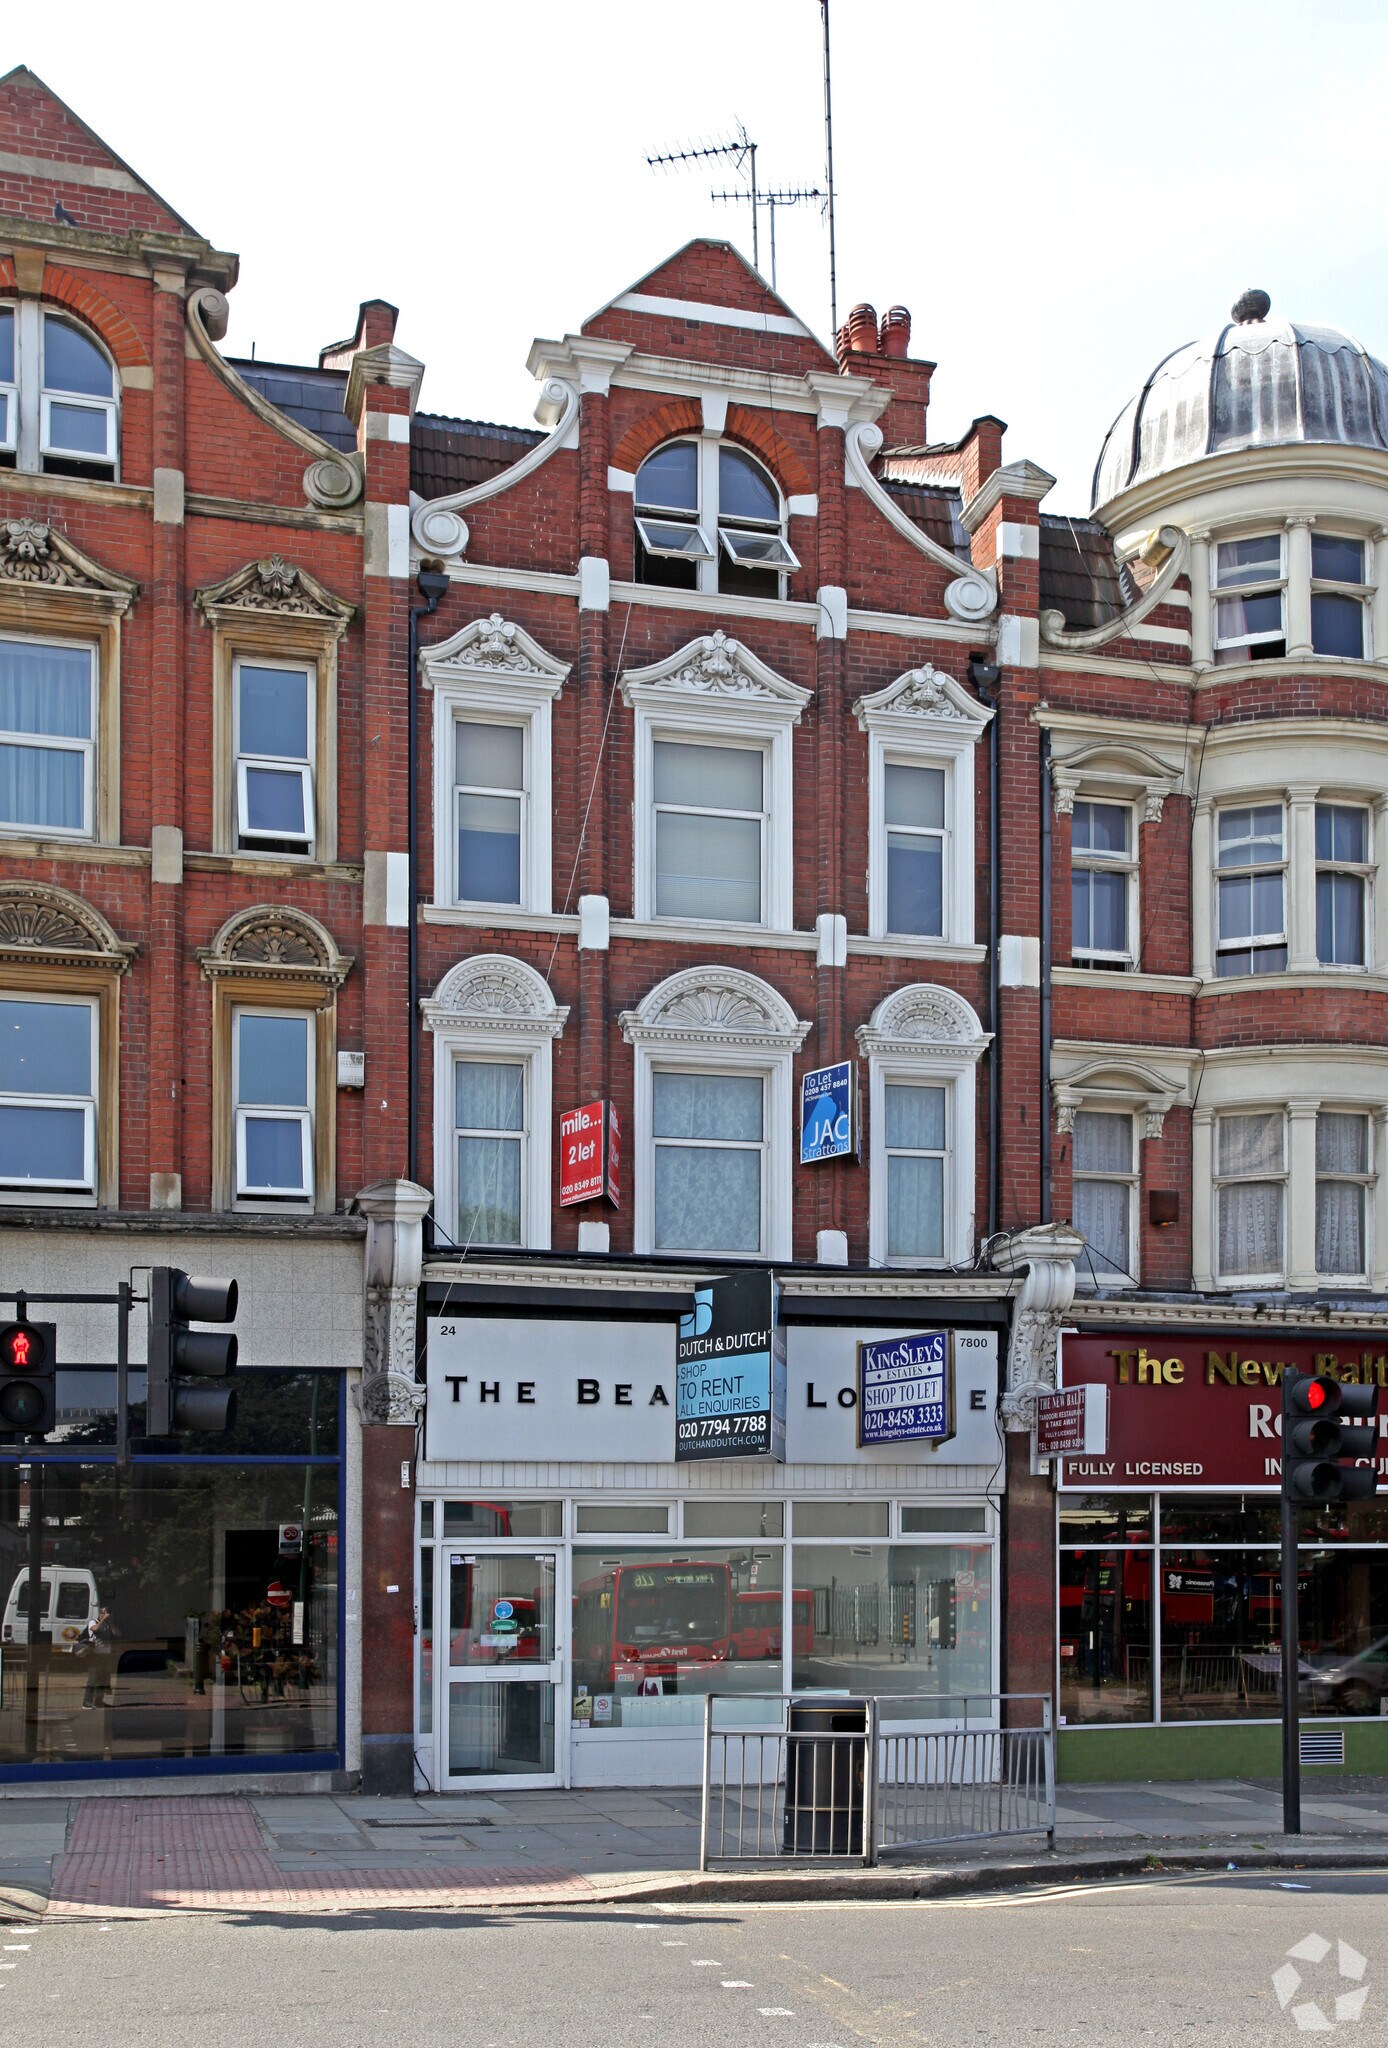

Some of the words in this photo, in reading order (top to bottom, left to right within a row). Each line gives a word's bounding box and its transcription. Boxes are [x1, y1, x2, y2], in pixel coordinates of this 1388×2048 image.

[805, 1086, 819, 1097] 0208
[820, 1083, 831, 1092] 457
[833, 1078, 848, 1089] 8840
[806, 1076, 816, 1088] To
[818, 1072, 832, 1085] Let
[562, 1110, 602, 1137] mile...
[810, 1114, 848, 1147] JAC
[568, 1145, 577, 1166] 2
[578, 1140, 596, 1162] let
[803, 1141, 848, 1160] Strattons
[561, 1184, 573, 1196] 020
[574, 1179, 589, 1192] 8349
[440, 1325, 456, 1336] 24
[680, 1338, 713, 1358] DUTCH
[715, 1337, 725, 1352] &
[726, 1331, 767, 1351] DUTCH
[960, 1338, 988, 1348] 7800
[680, 1363, 707, 1380] SHOP
[886, 1365, 923, 1380] ESTATES
[1110, 1348, 1185, 1385] The
[1205, 1351, 1296, 1387] New
[445, 1375, 536, 1404] THE
[577, 1378, 669, 1406] BEA
[680, 1381, 697, 1401] TO
[701, 1375, 744, 1398] RENT
[866, 1386, 896, 1406] SHOP
[899, 1384, 914, 1402] TO
[917, 1380, 938, 1399] LET
[680, 1403, 696, 1417] ALL
[698, 1395, 760, 1415] ENQUIRIES
[1040, 1396, 1051, 1411] THE
[1052, 1394, 1065, 1409] NEW
[865, 1408, 914, 1430] 020-8458
[917, 1404, 943, 1425] 3333
[1039, 1413, 1059, 1421] TANDOORI
[1059, 1408, 1085, 1419] RESTAURANT
[1063, 1418, 1077, 1426] AWAY
[679, 1422, 698, 1439] 020
[700, 1418, 730, 1437] 7794
[733, 1415, 767, 1433] 7788
[865, 1423, 942, 1439] www.kingsleys-estates.co.uk
[1057, 1429, 1077, 1437] LICENSED
[679, 1434, 765, 1451] DUTCHANDDUTCH.COM
[1068, 1462, 1116, 1476] FULLY
[1125, 1462, 1204, 1476] LICENSED
